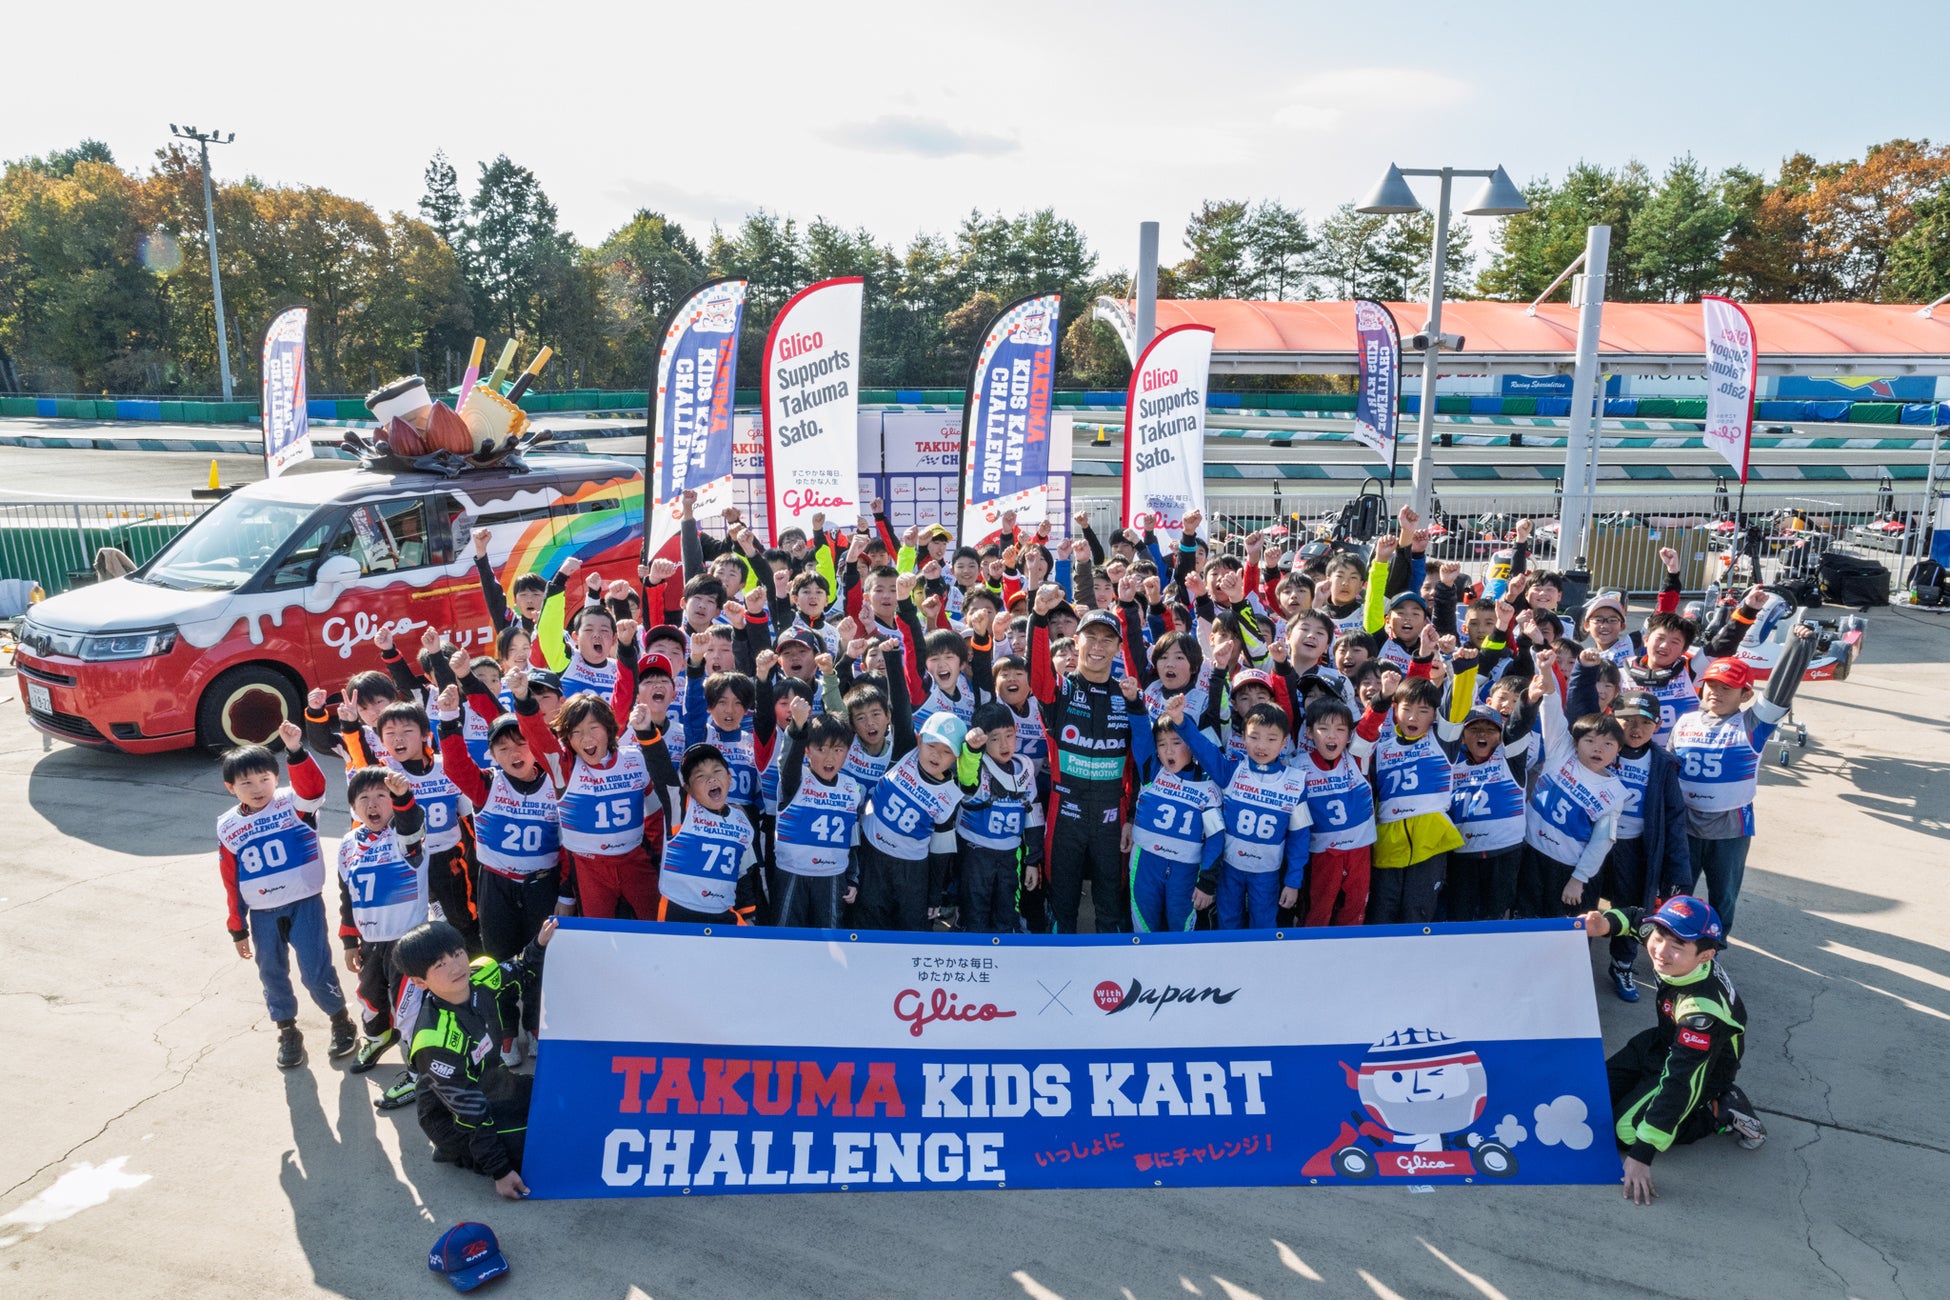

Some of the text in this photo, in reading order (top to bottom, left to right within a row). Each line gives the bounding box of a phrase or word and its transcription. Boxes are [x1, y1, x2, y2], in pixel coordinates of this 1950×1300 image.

[778, 331, 824, 363] Glico
[777, 350, 851, 391] Supports
[1142, 368, 1178, 393] Glico
[690, 348, 717, 469] KIDS KART
[779, 380, 849, 418] Takuma
[1026, 348, 1052, 444] TAKUMA
[1139, 387, 1199, 419] Supports
[672, 358, 695, 492] CHALLENGE
[982, 367, 1010, 495] CHALLENGE
[1004, 358, 1032, 477] KIDS KART
[1138, 415, 1197, 446] Takuma
[778, 420, 823, 448] Sato.
[915, 441, 961, 452] TAKUM
[940, 427, 961, 438] Glic
[1136, 450, 1175, 473] Sato.
[783, 489, 853, 517] Glico
[1493, 566, 1511, 578] 75
[1386, 654, 1408, 664] AKUMA
[1734, 650, 1768, 662] lico
[1066, 765, 1119, 778] AUTOMOTIVE
[1068, 755, 1118, 768] Panasonic
[1624, 764, 1640, 773] KIDS
[1684, 752, 1722, 778] 65
[594, 781, 632, 793] HALLENGE
[624, 772, 643, 781] KART
[1306, 778, 1328, 786] KUMA
[1386, 765, 1419, 794] 75
[522, 800, 540, 808] KIDS
[900, 778, 933, 810] CHALLENGE
[1182, 786, 1198, 796] KIDS
[1234, 782, 1298, 804] TAKUMA KIDS KART
[1243, 793, 1284, 808] CHALLENGE
[1561, 778, 1592, 809] CHALLENGE
[1576, 784, 1591, 800] KIDS
[1589, 794, 1604, 812] KART
[254, 816, 272, 826] KIDS
[272, 810, 292, 822] KART
[594, 798, 632, 828] 15
[882, 792, 920, 834] 58
[988, 810, 1020, 834] 69
[1153, 804, 1194, 835] 31
[1236, 808, 1278, 840] 86
[1326, 800, 1348, 826] 3
[1552, 798, 1573, 826] 5
[501, 823, 542, 852] 20
[811, 814, 845, 843] 42
[241, 838, 288, 874] 80
[701, 843, 736, 875] 73
[911, 957, 1000, 970] すこやかな毎日、
[918, 970, 990, 983] ゆたかな人生
[1096, 988, 1121, 998] With
[1100, 996, 1120, 1006] you
[1105, 977, 1242, 1021] Japan
[894, 988, 1017, 1038] Glico
[1682, 1032, 1709, 1046] Glico
[431, 1062, 454, 1077] OMP
[612, 1056, 1272, 1118] TAKUMA KIDS KART
[601, 1128, 1006, 1186] CHALLENGE
[1034, 1132, 1125, 1167] いっしょに
[1134, 1134, 1273, 1172] にチャレンジ！
[1396, 1152, 1455, 1173] Glico
